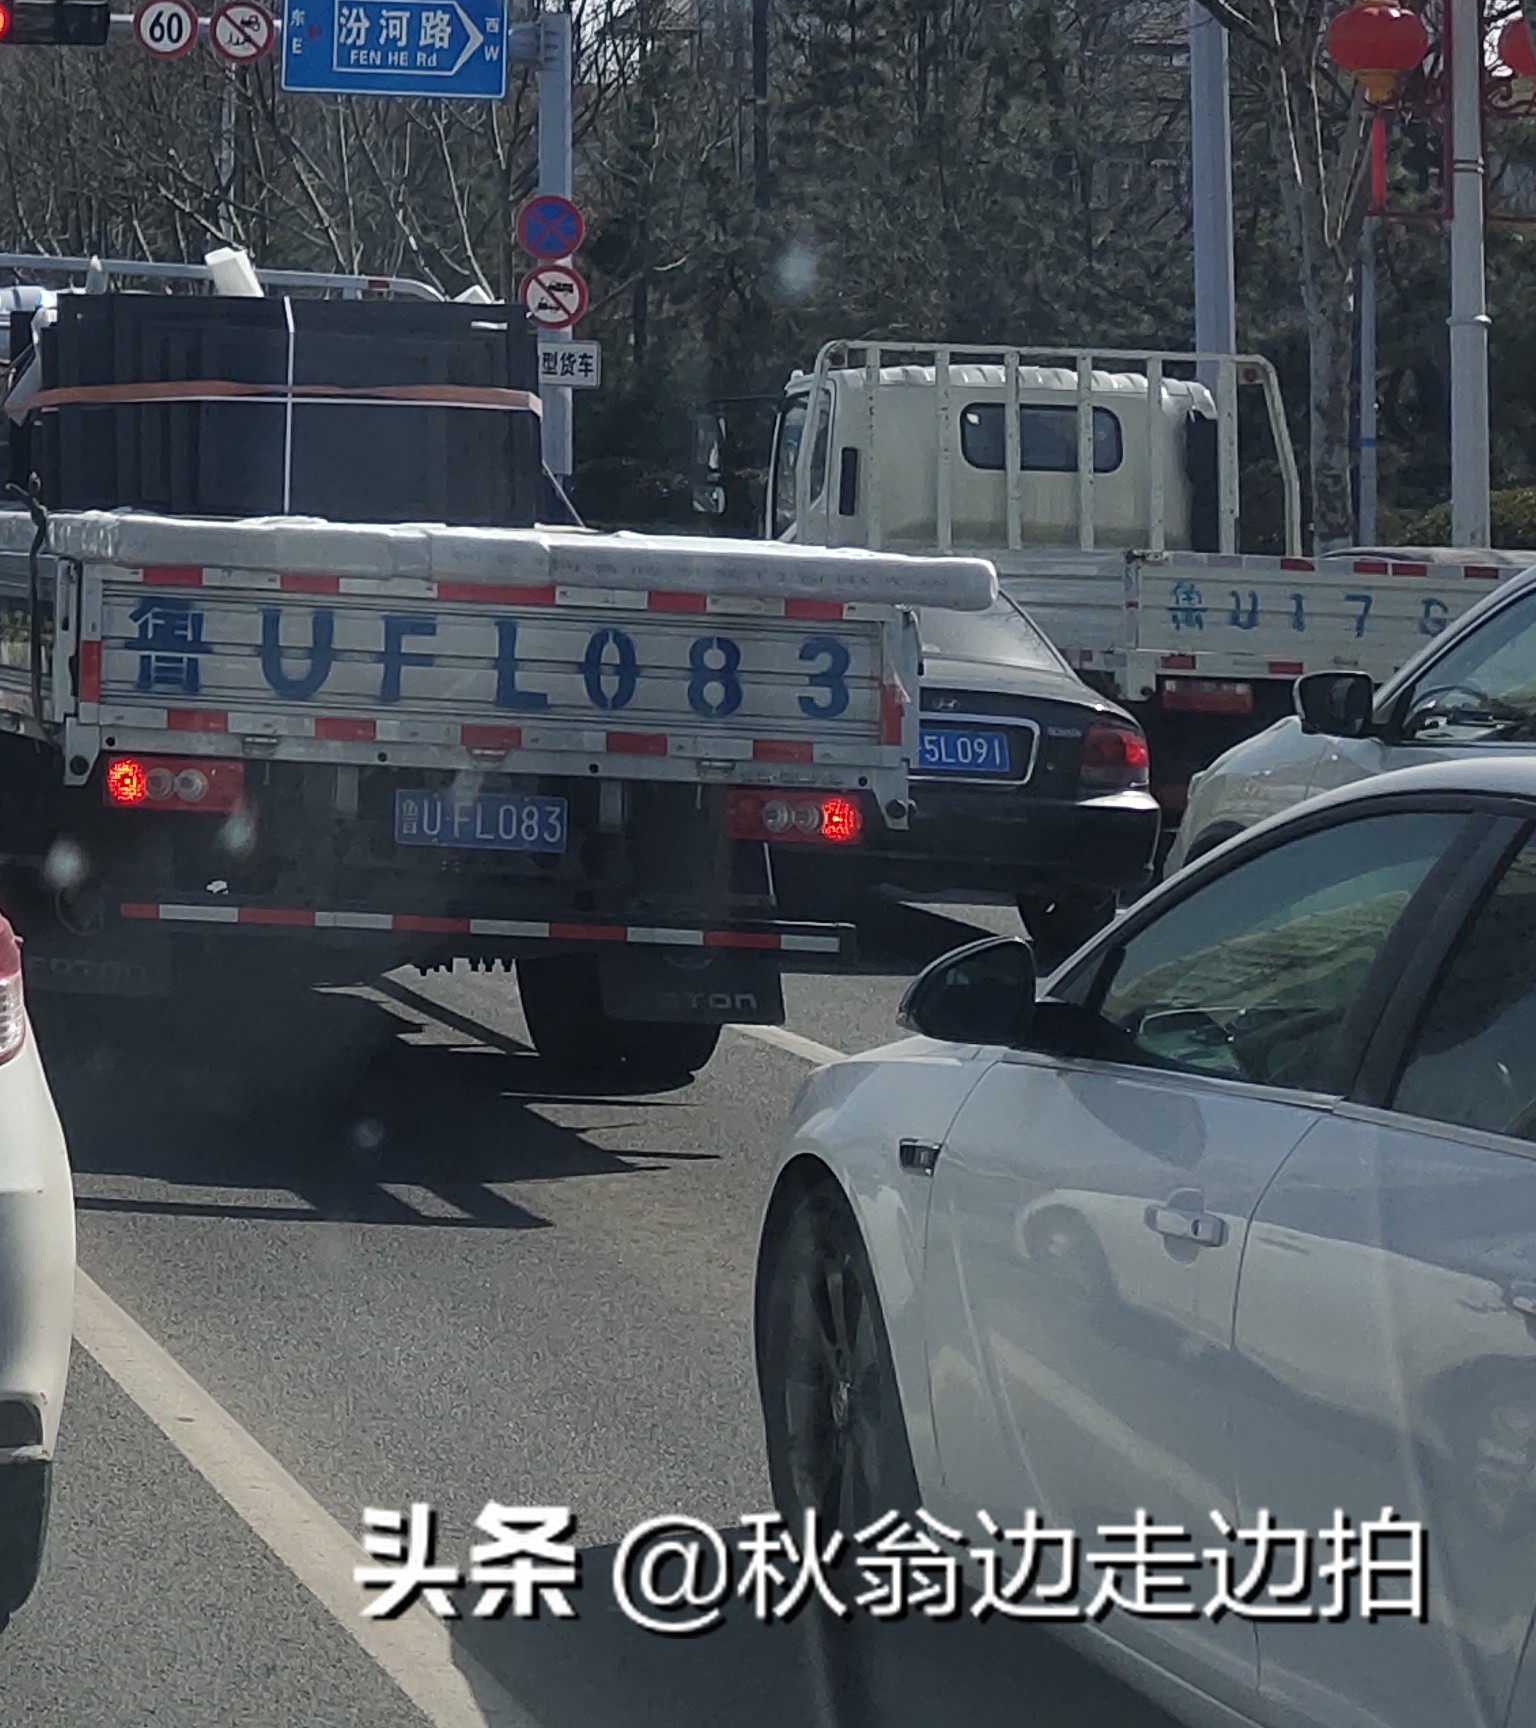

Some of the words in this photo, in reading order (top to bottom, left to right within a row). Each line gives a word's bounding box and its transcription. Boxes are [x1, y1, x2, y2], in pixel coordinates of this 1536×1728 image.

[149, 10, 183, 44] 60
[291, 9, 305, 27] 东
[485, 16, 500, 34] 西
[339, 6, 453, 50] 汾河路
[292, 38, 303, 55] E
[484, 46, 500, 62] W
[350, 49, 382, 66] FEN
[388, 51, 409, 67] HE
[416, 52, 438, 68] Rd
[541, 351, 594, 378] 型货车
[923, 734, 1002, 767] 5L091
